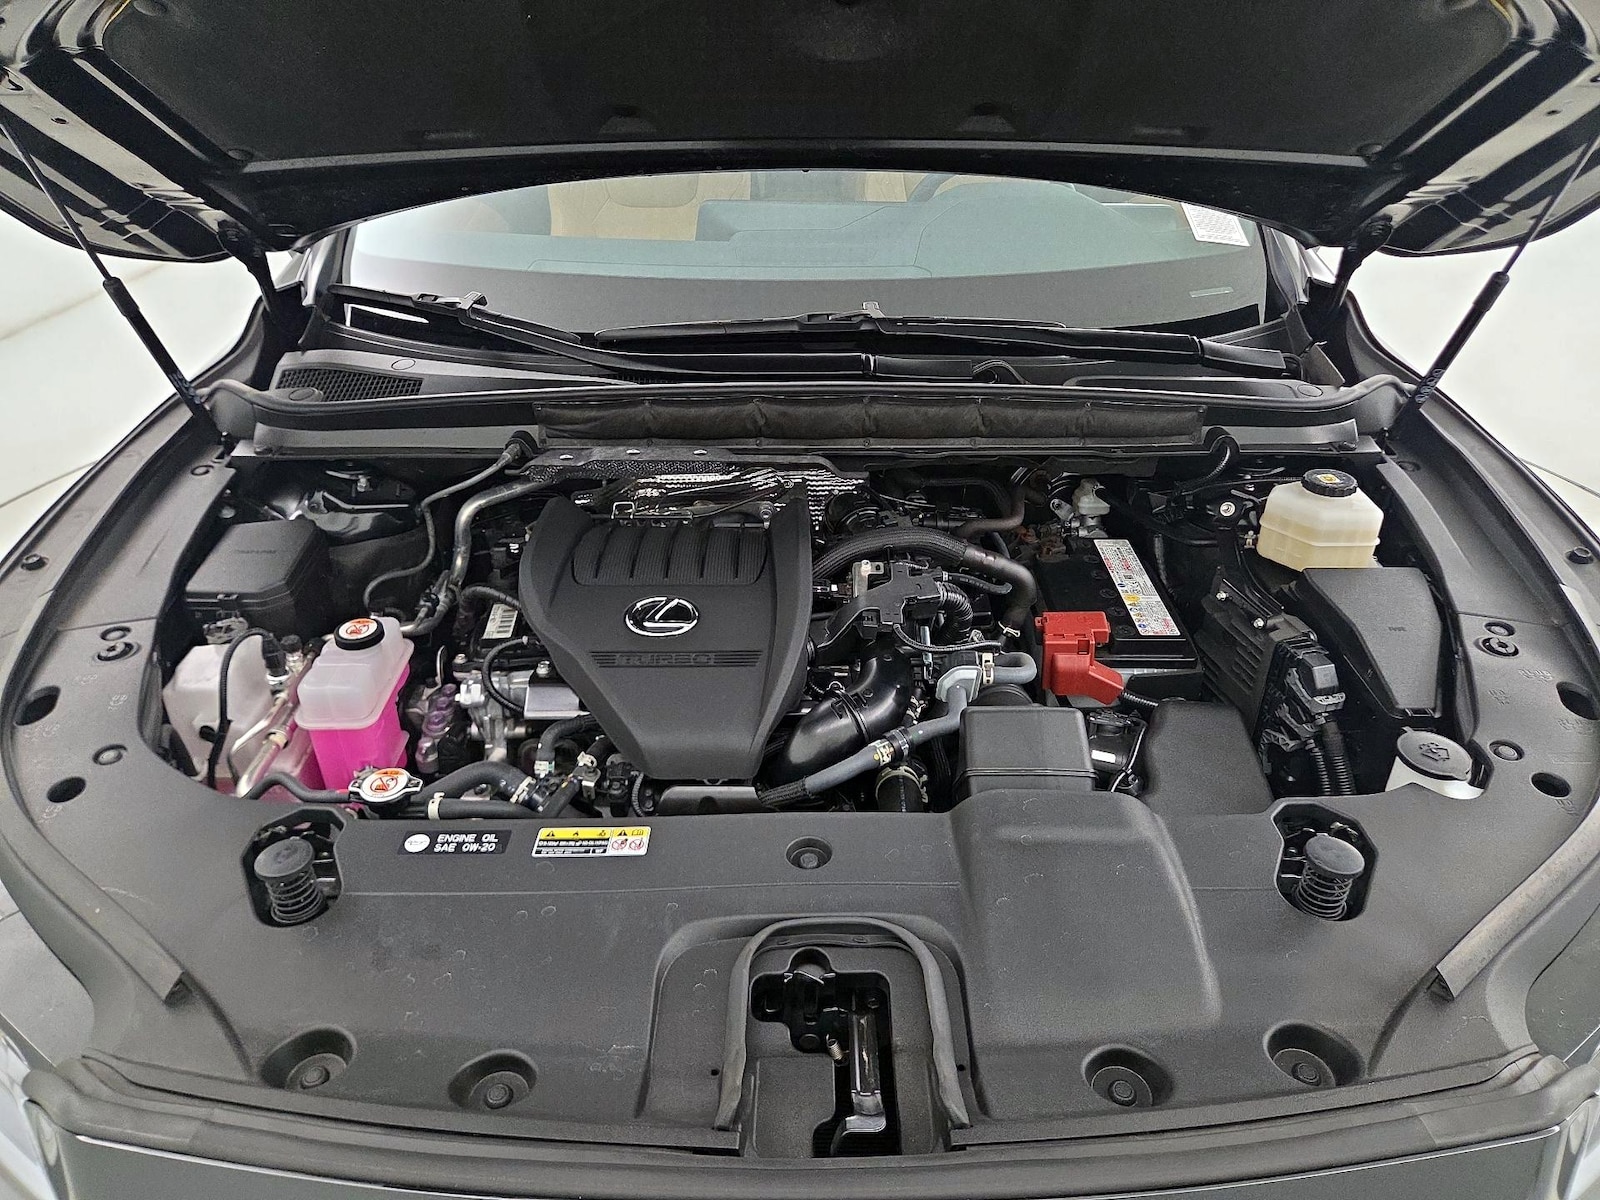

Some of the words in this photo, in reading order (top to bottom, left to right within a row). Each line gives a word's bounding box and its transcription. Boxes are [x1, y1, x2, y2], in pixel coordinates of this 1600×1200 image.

[437, 833, 477, 843] ENGINE
[482, 833, 499, 843] OIL
[433, 842, 458, 852] SAE
[462, 842, 496, 852] 0W-20
